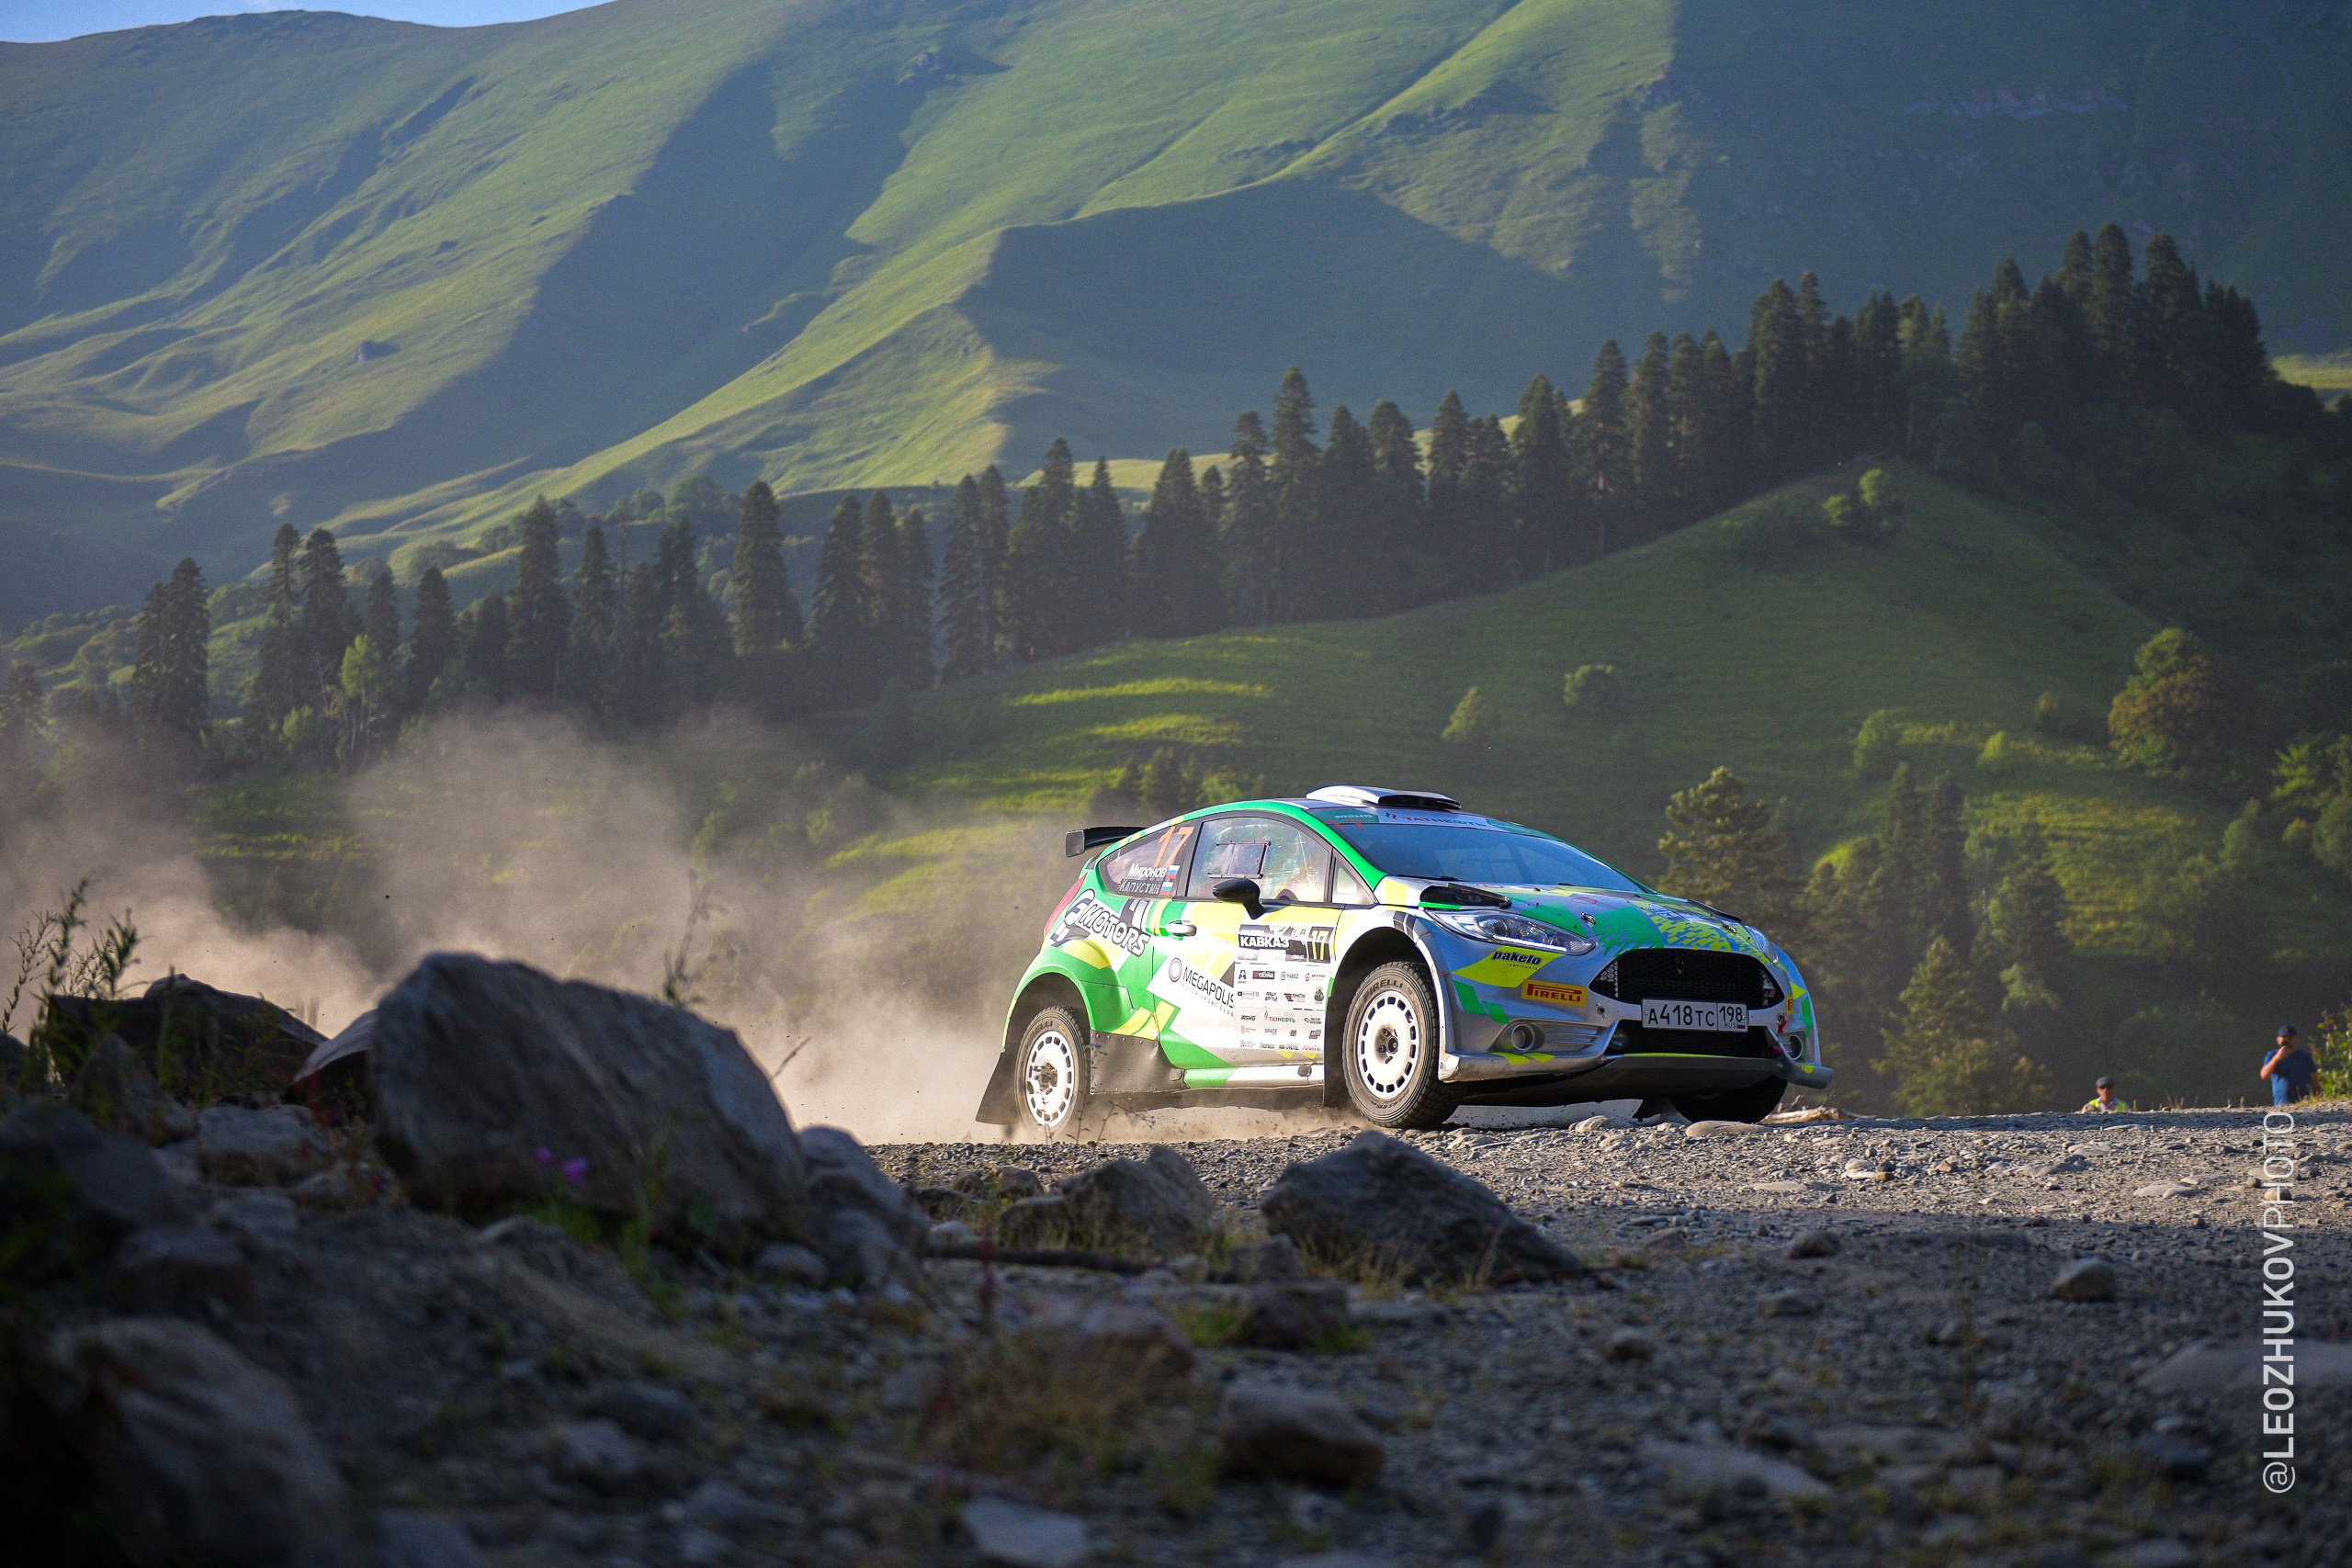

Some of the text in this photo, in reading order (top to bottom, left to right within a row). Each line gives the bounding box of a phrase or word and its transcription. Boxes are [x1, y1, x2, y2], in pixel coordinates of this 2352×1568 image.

[1154, 826, 1194, 867] 17
[1127, 863, 1167, 880] Миронов
[1240, 935, 1289, 948] КАВКАЗ
[1308, 930, 1330, 961] 17
[1491, 950, 1543, 965] pakelo
[1182, 966, 1235, 1009] MEGAPOLIS
[1363, 977, 1403, 1002] PIRELLI
[1526, 983, 1582, 1002] PIRELLI
[1647, 1004, 1743, 1027] А418ТС 198
